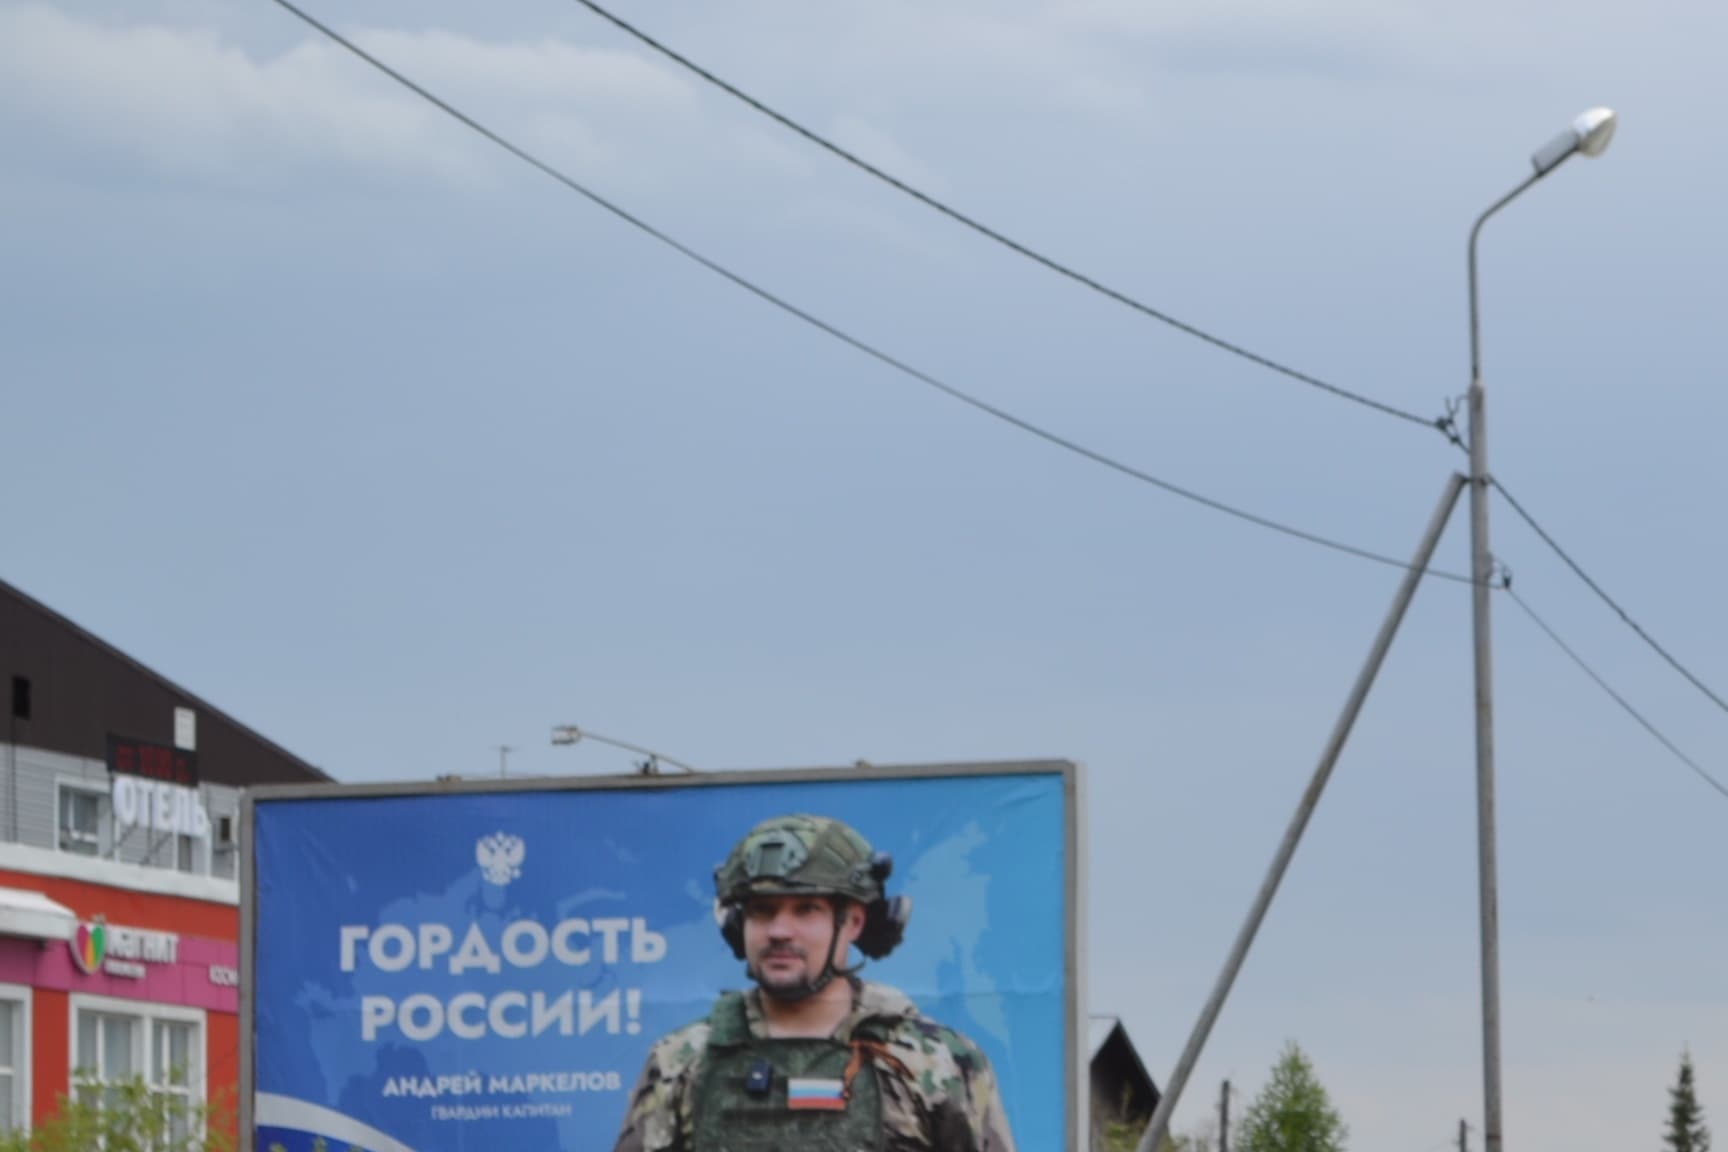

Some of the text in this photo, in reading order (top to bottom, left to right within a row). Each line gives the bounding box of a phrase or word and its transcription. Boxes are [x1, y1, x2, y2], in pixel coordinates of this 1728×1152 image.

[113, 774, 211, 837] ОТЕЛЬ
[340, 917, 668, 976] ГОРДОСТЬ
[361, 989, 642, 1041] РОССИИ!
[383, 1069, 622, 1098] АНДРЕЙ МАРКЕЛОВ
[431, 1104, 572, 1121] ГВАРДИИ КАПИТАН
